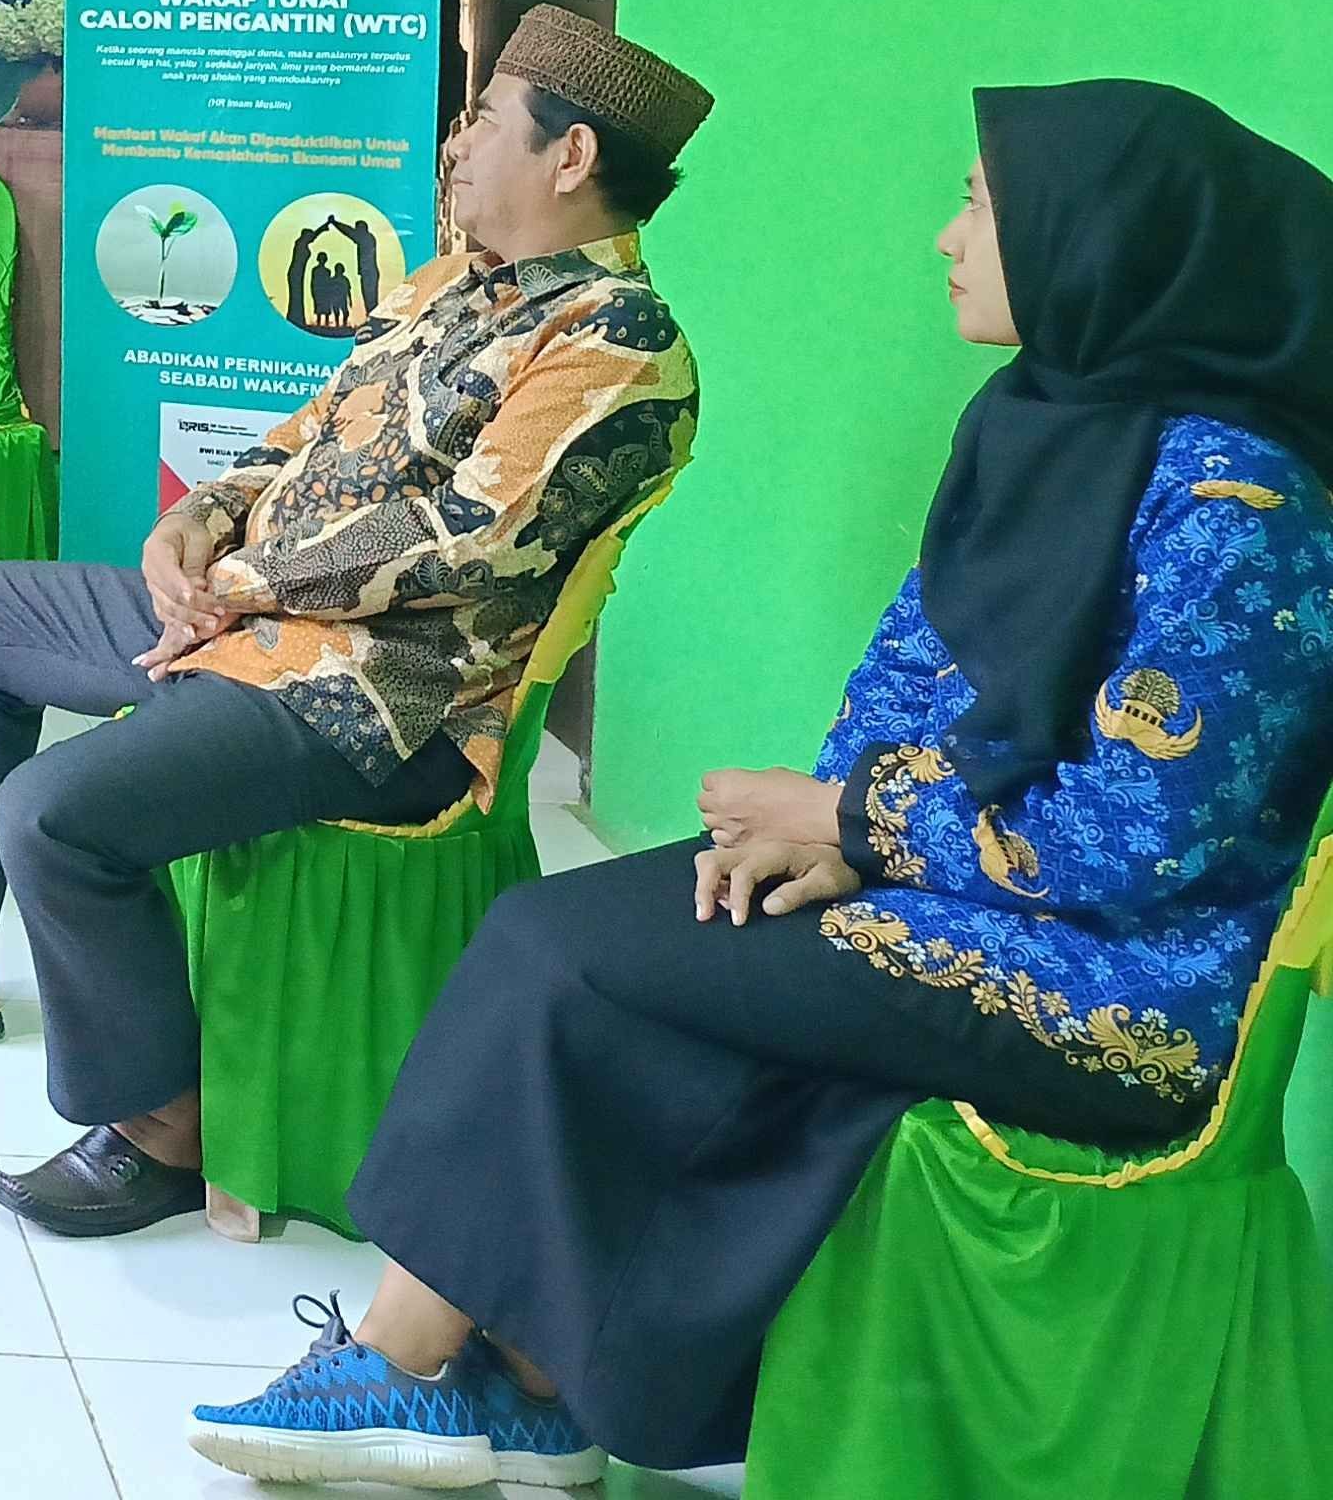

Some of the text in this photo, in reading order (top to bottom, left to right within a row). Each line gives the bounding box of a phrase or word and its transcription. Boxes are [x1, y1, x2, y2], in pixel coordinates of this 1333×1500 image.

[79, 10, 427, 39] CALON PENGANTIN (WTC)
[207, 47, 255, 58] meninggal
[287, 50, 313, 59] maka
[315, 51, 368, 61] amalannya
[370, 51, 411, 61] terputus
[136, 58, 154, 68] tiga
[303, 64, 328, 73] yang
[386, 64, 406, 73] dan
[186, 73, 209, 82] yang
[243, 75, 266, 84] yang
[268, 75, 341, 86] mendoakannya
[159, 129, 207, 143] Wakaf
[208, 130, 247, 144] Akan
[364, 137, 410, 151] Untuk
[292, 150, 357, 166] Ekonomi
[359, 155, 402, 169] Umat
[124, 349, 219, 369] ABADIKAN
[159, 370, 238, 390] SEABADI
